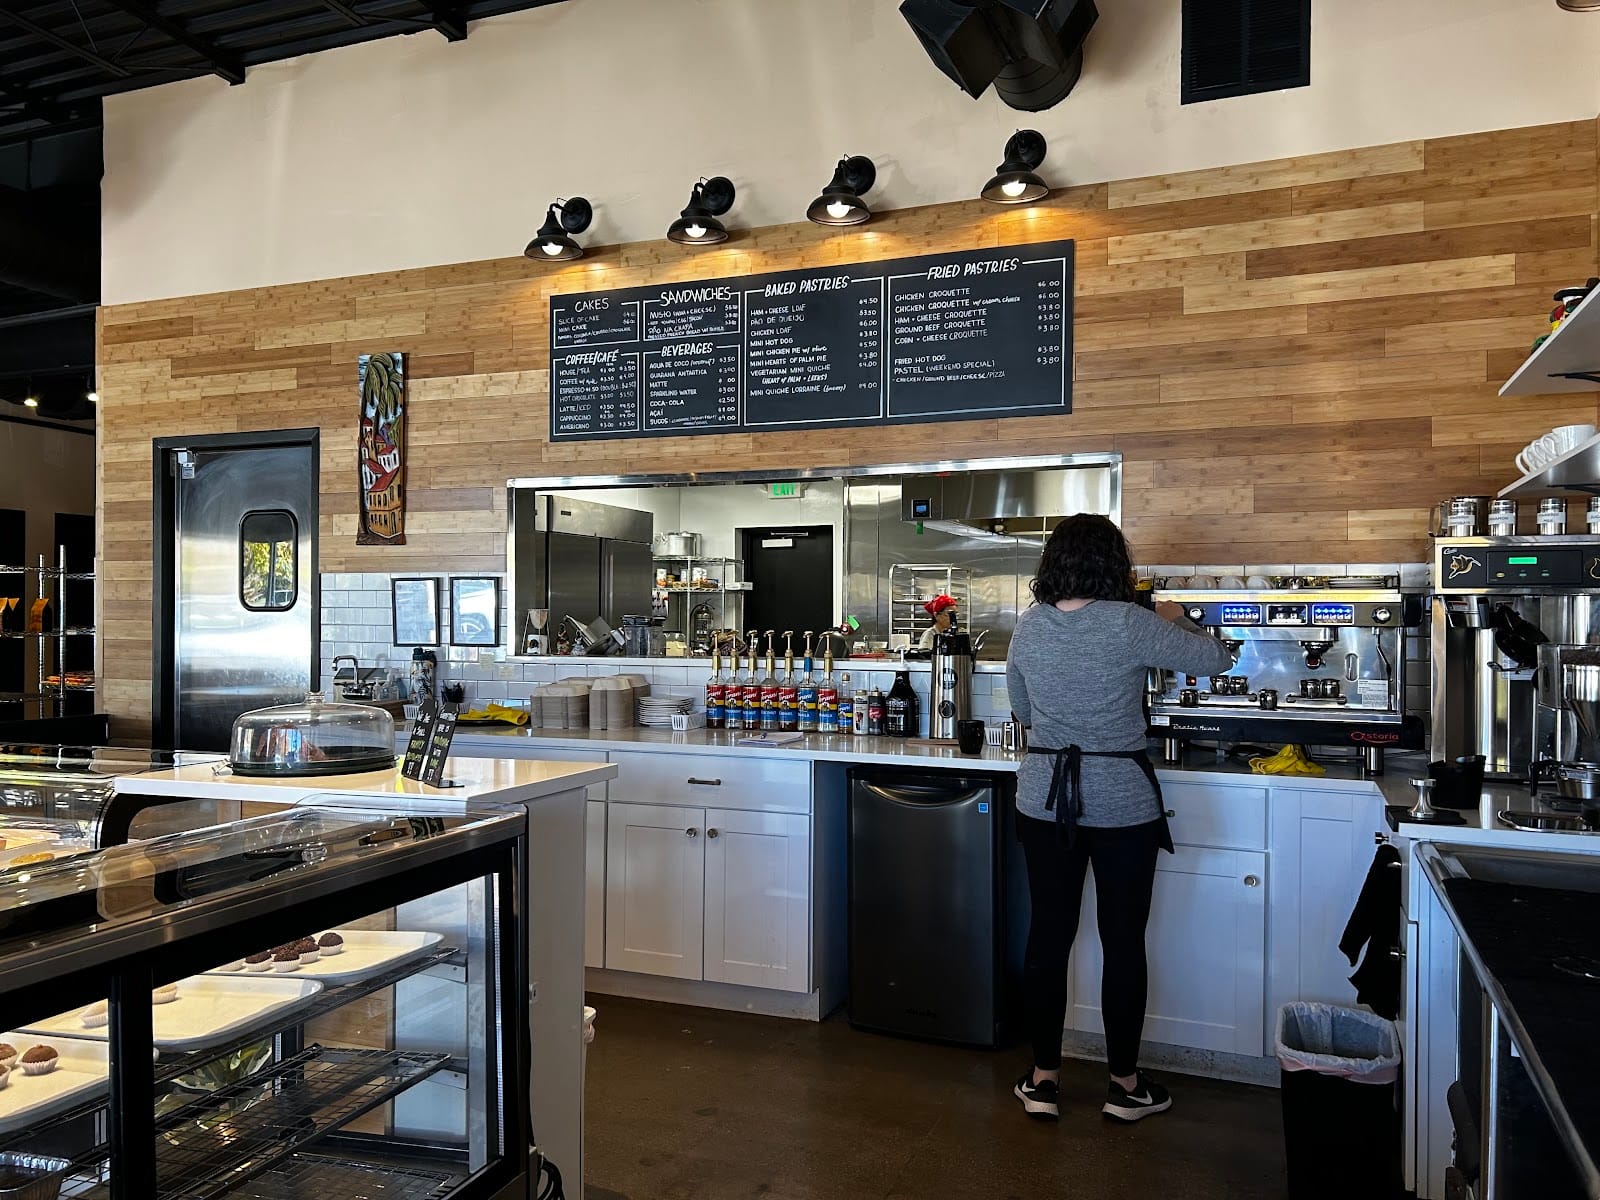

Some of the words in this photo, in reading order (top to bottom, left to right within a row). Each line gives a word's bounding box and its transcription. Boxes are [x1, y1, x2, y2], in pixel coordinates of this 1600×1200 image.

[927, 264, 960, 280] FRIED
[963, 258, 1019, 276] PASTRIES
[765, 282, 796, 297] BAKED
[799, 276, 850, 293] PASTRIES
[660, 287, 731, 306] SANDWICHES
[894, 292, 925, 302] CHICKEN
[928, 288, 970, 298] CROQUETTE
[575, 298, 609, 312] CAKES
[769, 306, 789, 314] CHEESE
[792, 304, 806, 312] LOAF
[895, 304, 925, 314] CHICKEN
[928, 299, 970, 310] CROQUETTE
[767, 316, 776, 324] DE
[894, 315, 910, 324] HAM
[917, 312, 941, 322] CHEESE
[945, 308, 987, 319] CROQUETTE
[751, 329, 775, 337] CHICKEN
[895, 325, 923, 334] GROUND
[925, 324, 941, 332] BEEF
[944, 319, 985, 330] CROQUETTE
[894, 337, 914, 345] CORN
[922, 333, 947, 342] CHEESE
[949, 329, 988, 340] CROQUETTE
[661, 342, 713, 357] BEVERAGES
[766, 348, 790, 356] CHICKEN
[565, 349, 619, 365] COFFEE/CAFÉ
[894, 357, 912, 365] FRIED
[751, 368, 786, 376] VEGETARIAN
[807, 364, 831, 372] QUICHE
[894, 365, 923, 375] PASTEL
[926, 363, 961, 373] (WEEKEND
[963, 360, 995, 369] SPECIAL)
[766, 387, 789, 395] QUICHE
[791, 385, 821, 394] LORRAINE
[560, 395, 571, 403] HOT
[650, 399, 684, 407] COCA-COLA
